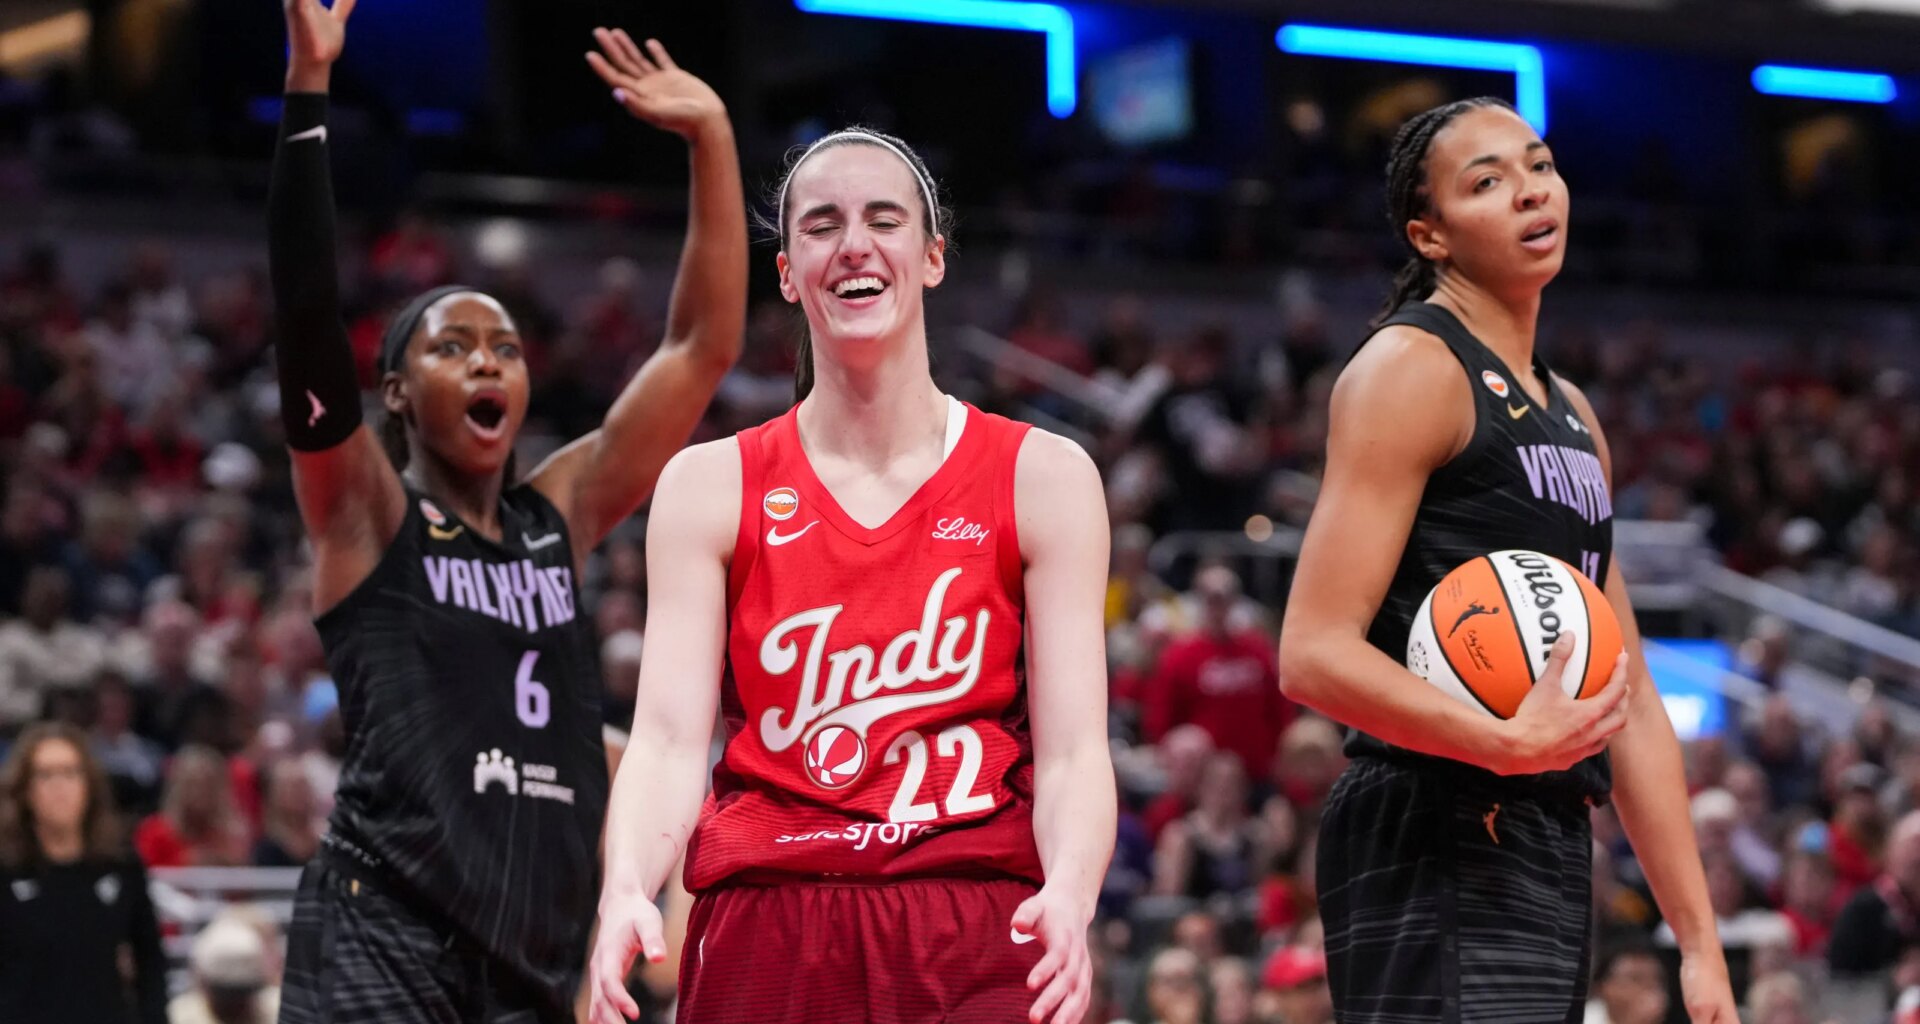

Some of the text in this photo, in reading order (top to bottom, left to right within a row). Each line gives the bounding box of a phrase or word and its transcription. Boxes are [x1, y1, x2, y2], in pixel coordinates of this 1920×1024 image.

[931, 517, 990, 546] Lilly
[514, 649, 550, 729] 6
[759, 566, 991, 753] Indy
[882, 724, 996, 824] 22
[775, 822, 941, 851] salesfor
